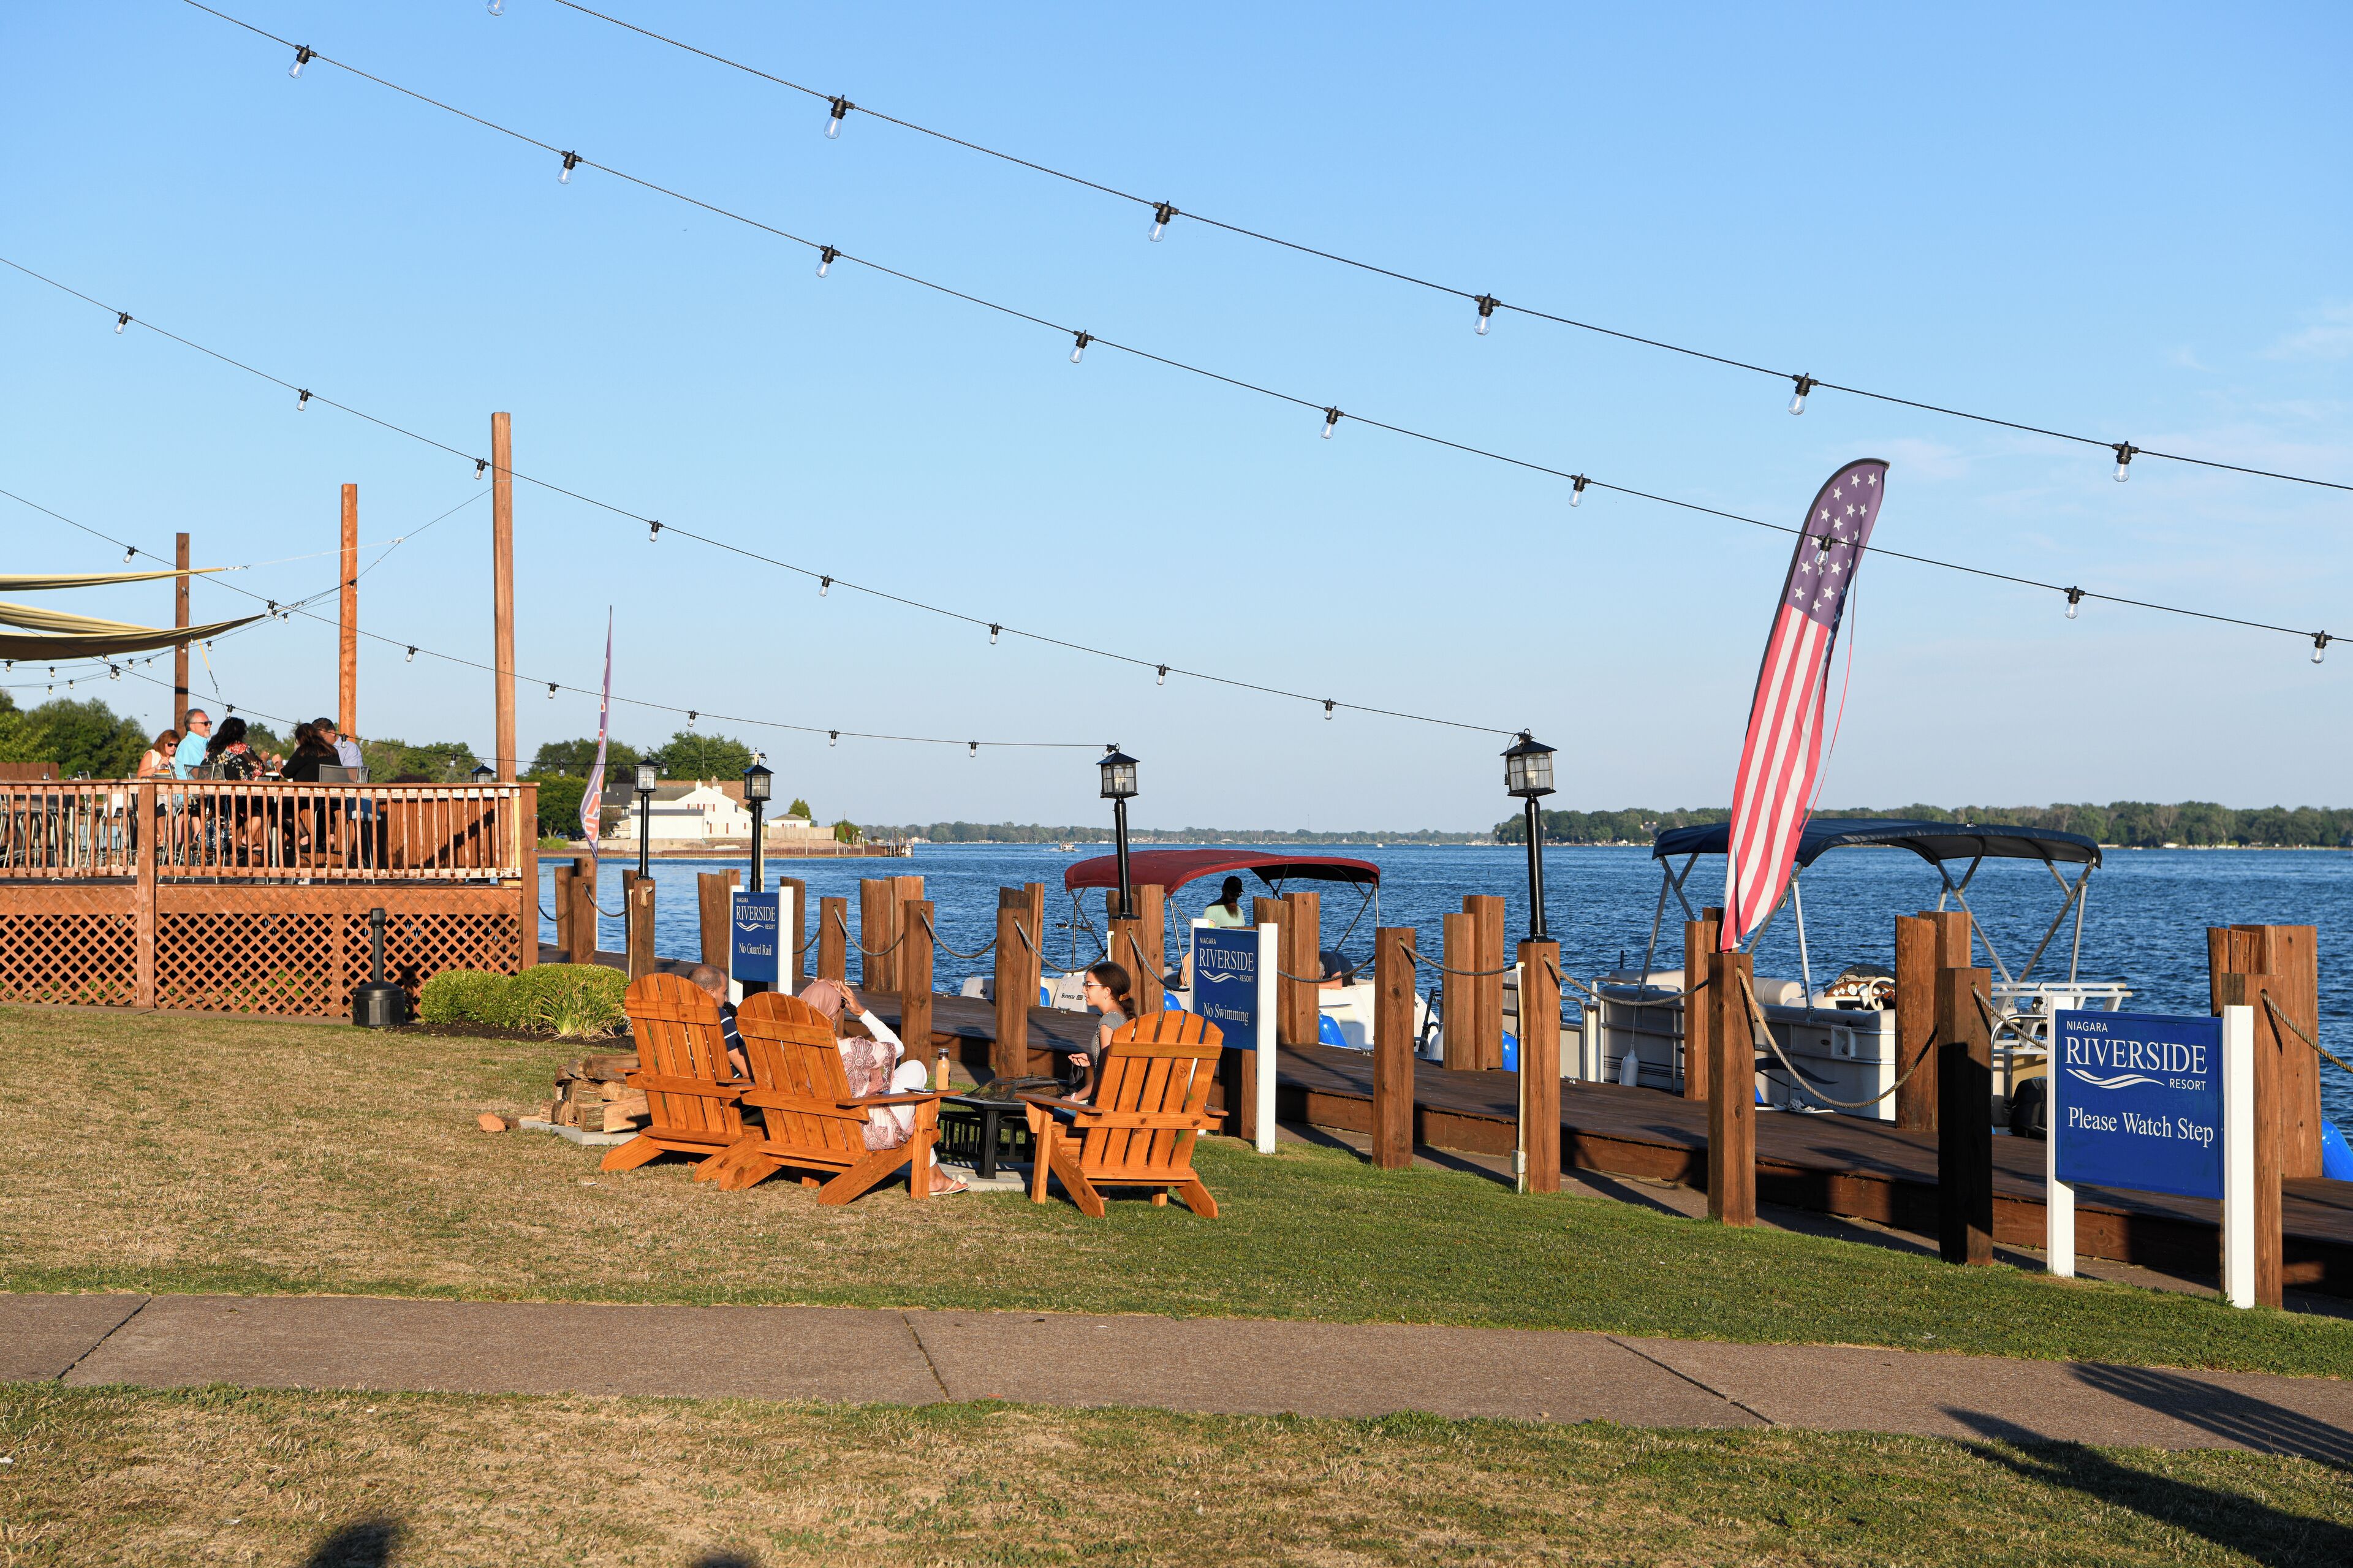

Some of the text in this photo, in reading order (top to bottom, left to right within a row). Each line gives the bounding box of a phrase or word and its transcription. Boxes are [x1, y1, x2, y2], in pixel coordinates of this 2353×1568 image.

[736, 906, 776, 921] RIVERSIDE
[739, 942, 771, 956] No Guard Rail
[1199, 949, 1254, 971] RIVERSIDE
[1203, 1002, 1249, 1026] No Swimming
[2066, 1020, 2108, 1032] NIAGARA
[2065, 1037, 2207, 1074] RIVERSIDE
[2170, 1078, 2206, 1091] RESORT
[2068, 1107, 2213, 1148] Please Watch Step
